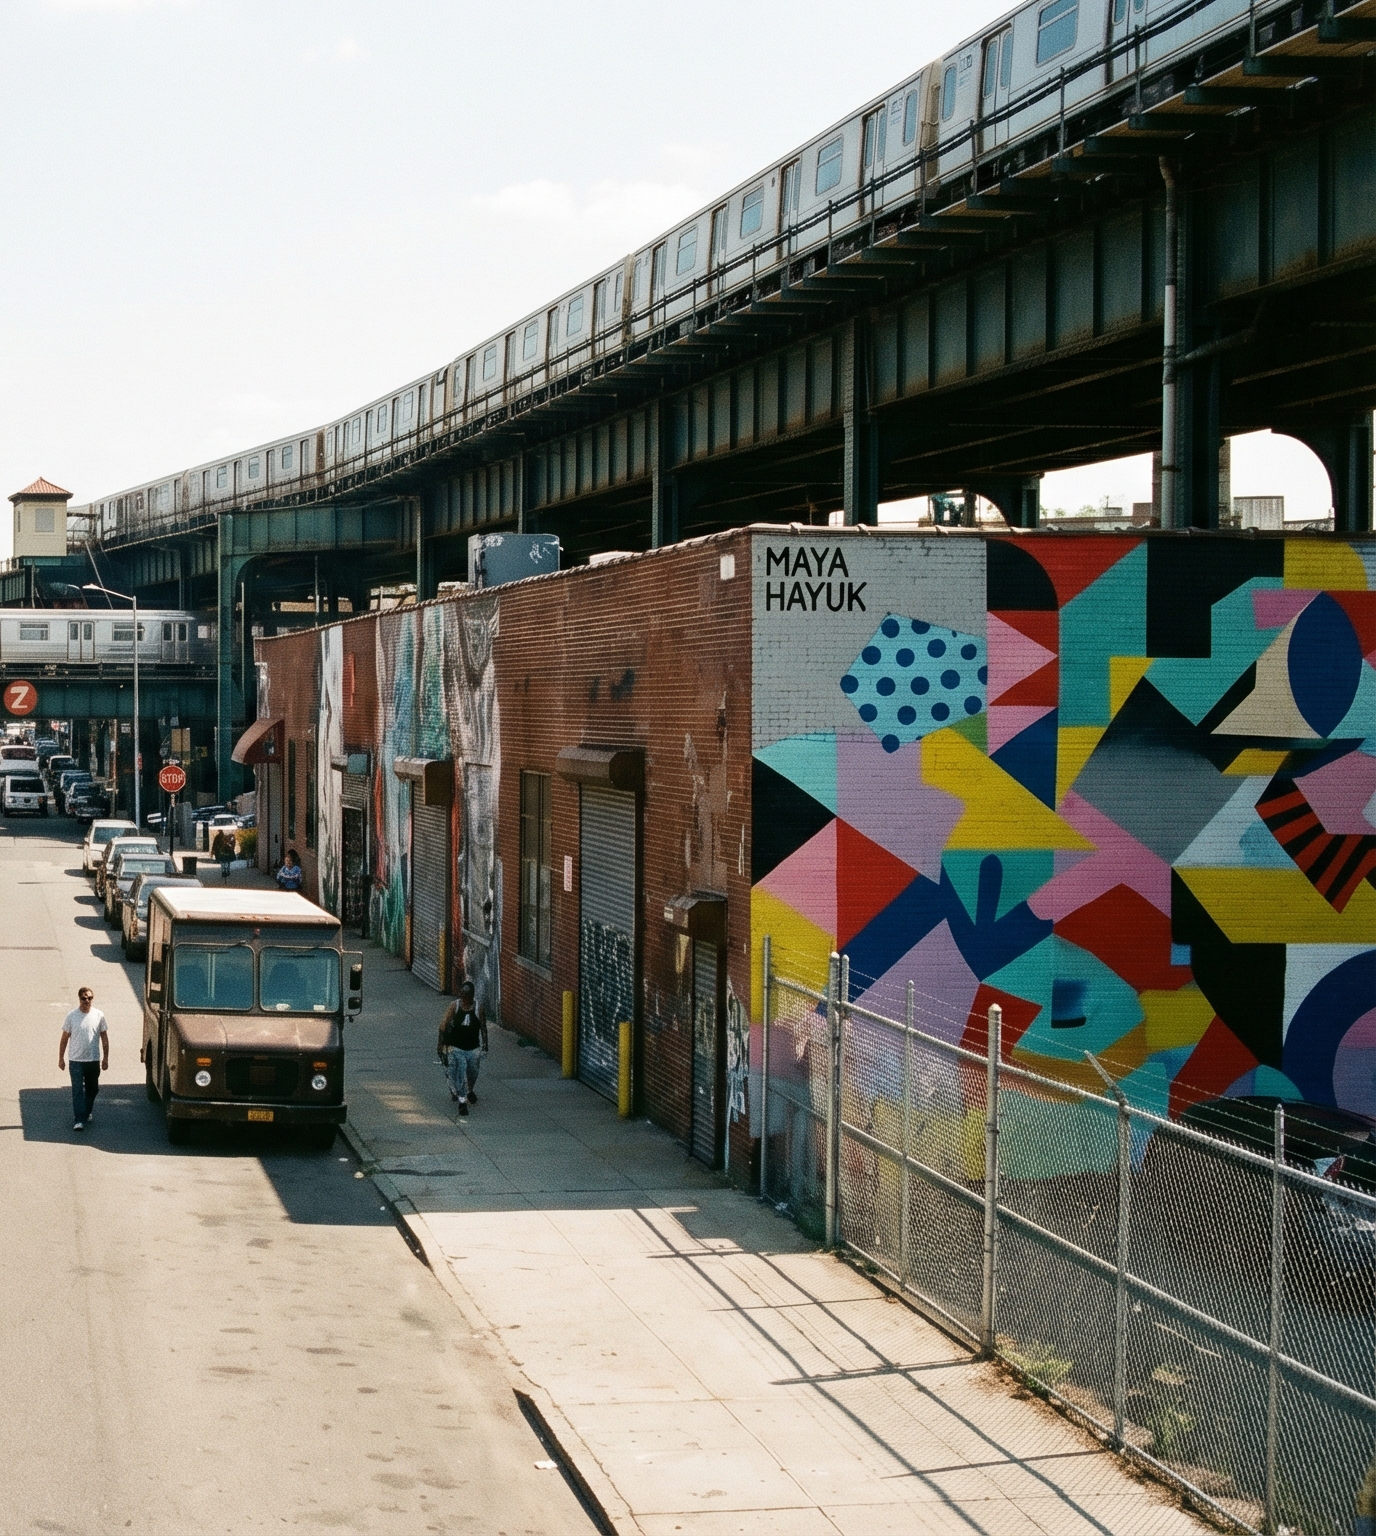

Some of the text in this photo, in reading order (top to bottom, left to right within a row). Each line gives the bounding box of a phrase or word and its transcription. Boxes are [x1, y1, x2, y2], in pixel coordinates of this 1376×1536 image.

[766, 546, 850, 577] MAYA
[766, 581, 867, 612] HAYUK
[10, 685, 29, 709] Z
[161, 773, 185, 784] STOP
